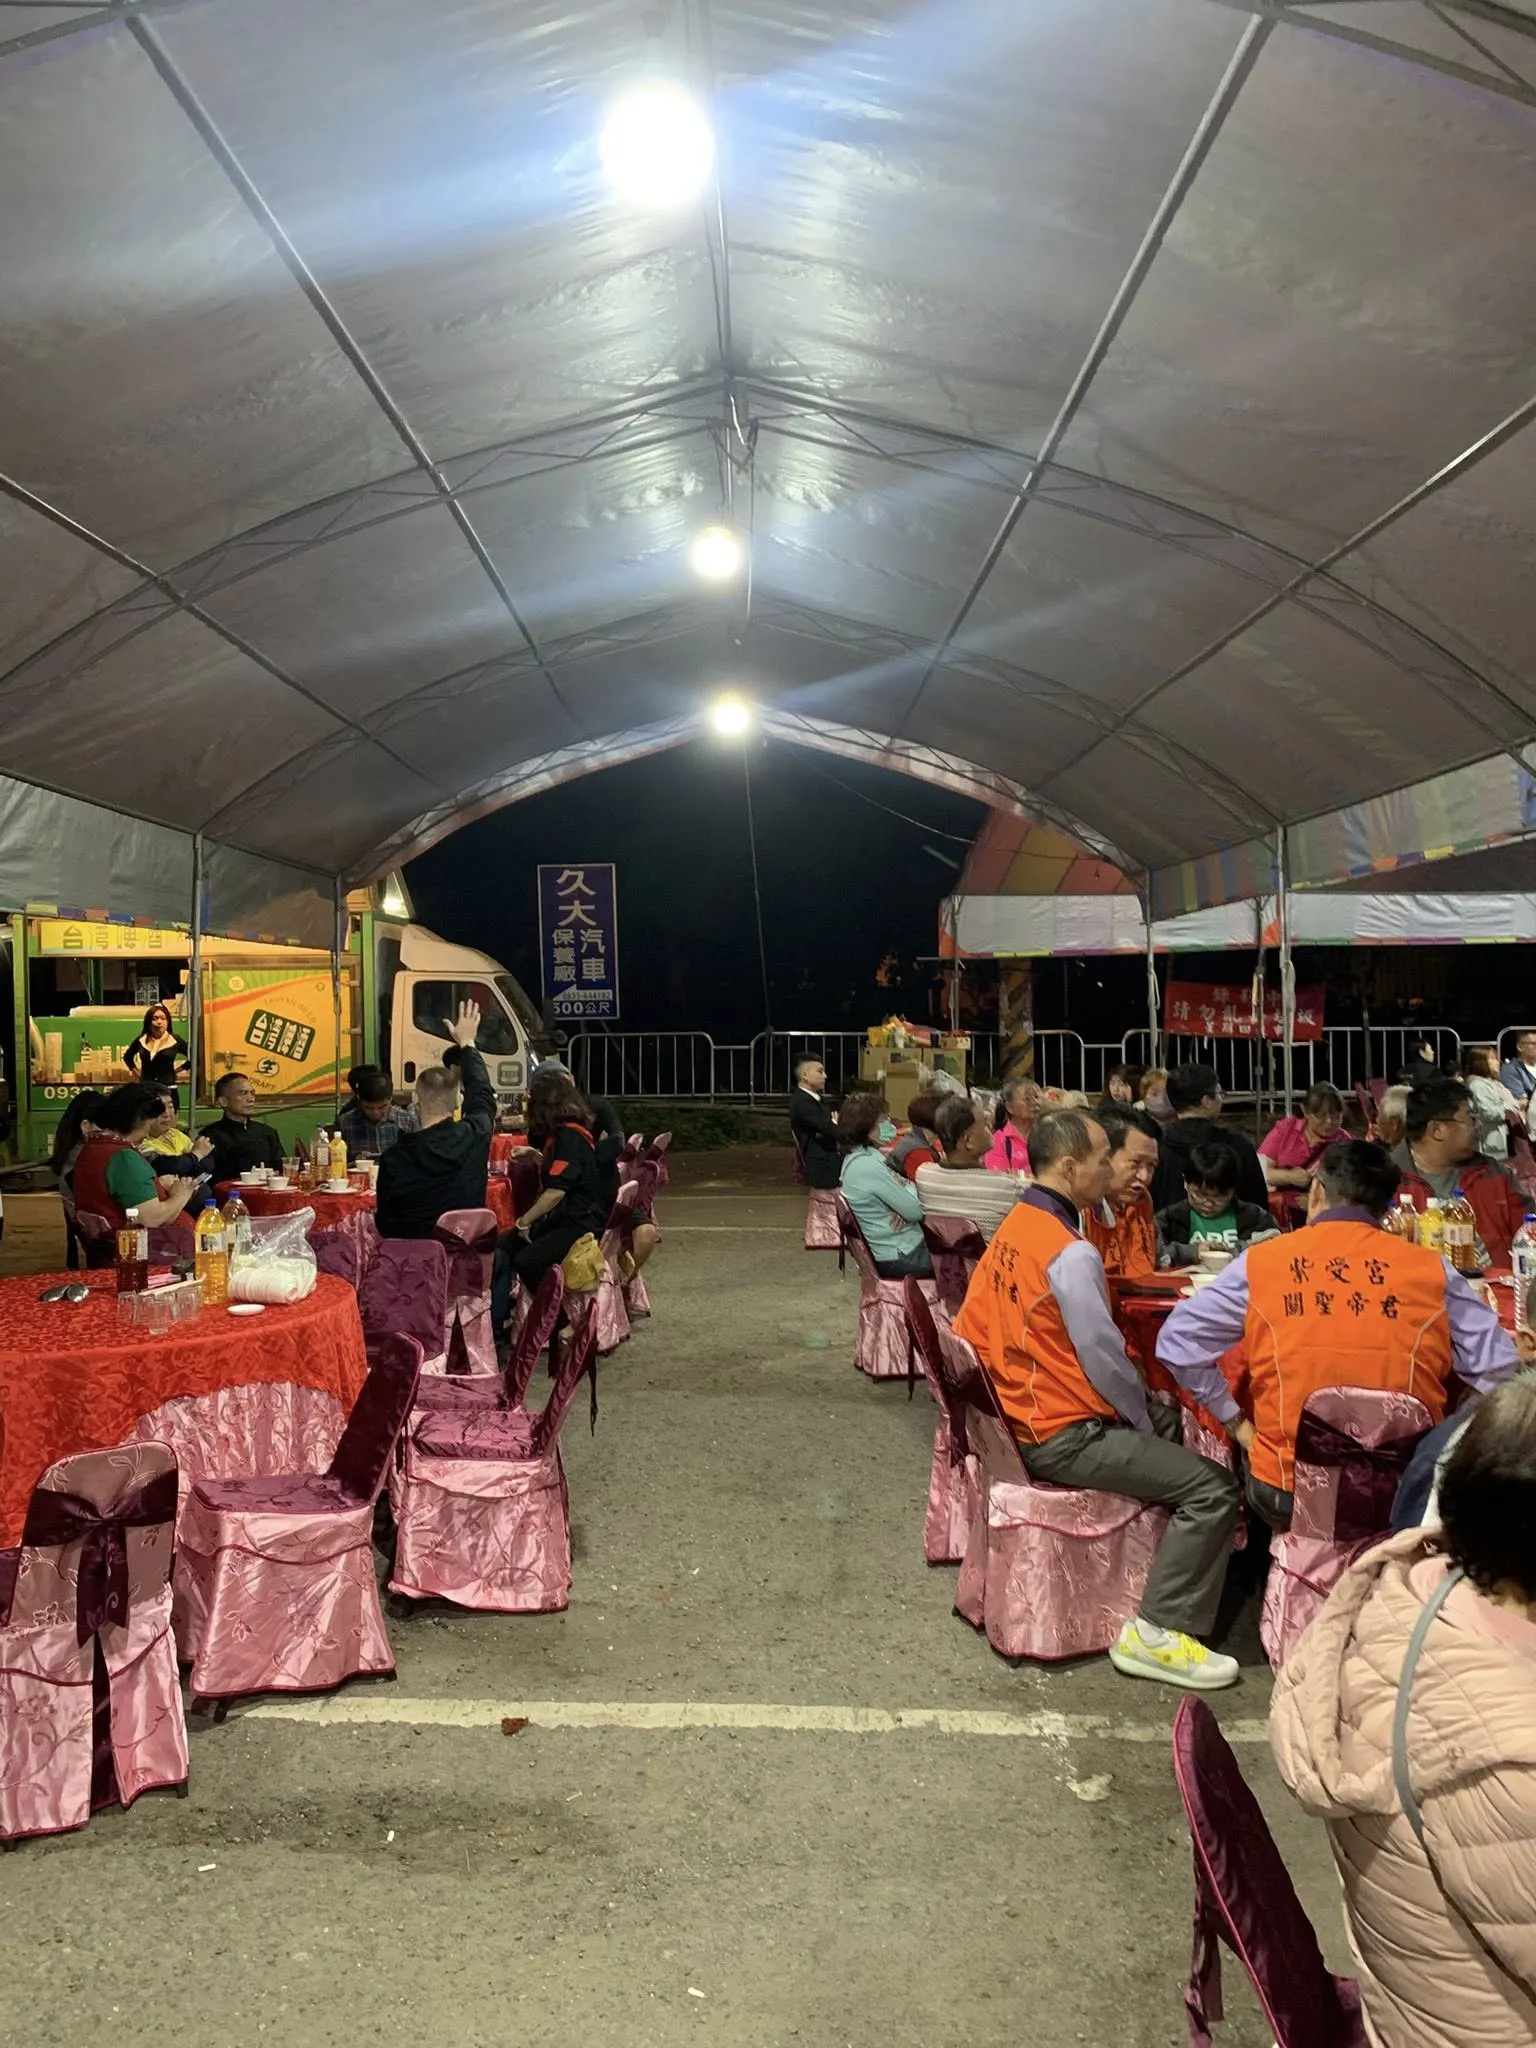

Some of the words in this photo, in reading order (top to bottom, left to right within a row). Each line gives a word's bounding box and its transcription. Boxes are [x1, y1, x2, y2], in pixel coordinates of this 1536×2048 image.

[556, 869, 596, 927] 久大
[552, 928, 577, 982] 保養廠
[580, 928, 606, 982] 汽車
[250, 1013, 312, 1059] 台灣啤酒
[1289, 1255, 1390, 1285] 紫受宮
[1283, 1290, 1400, 1319] 關聖帝君
